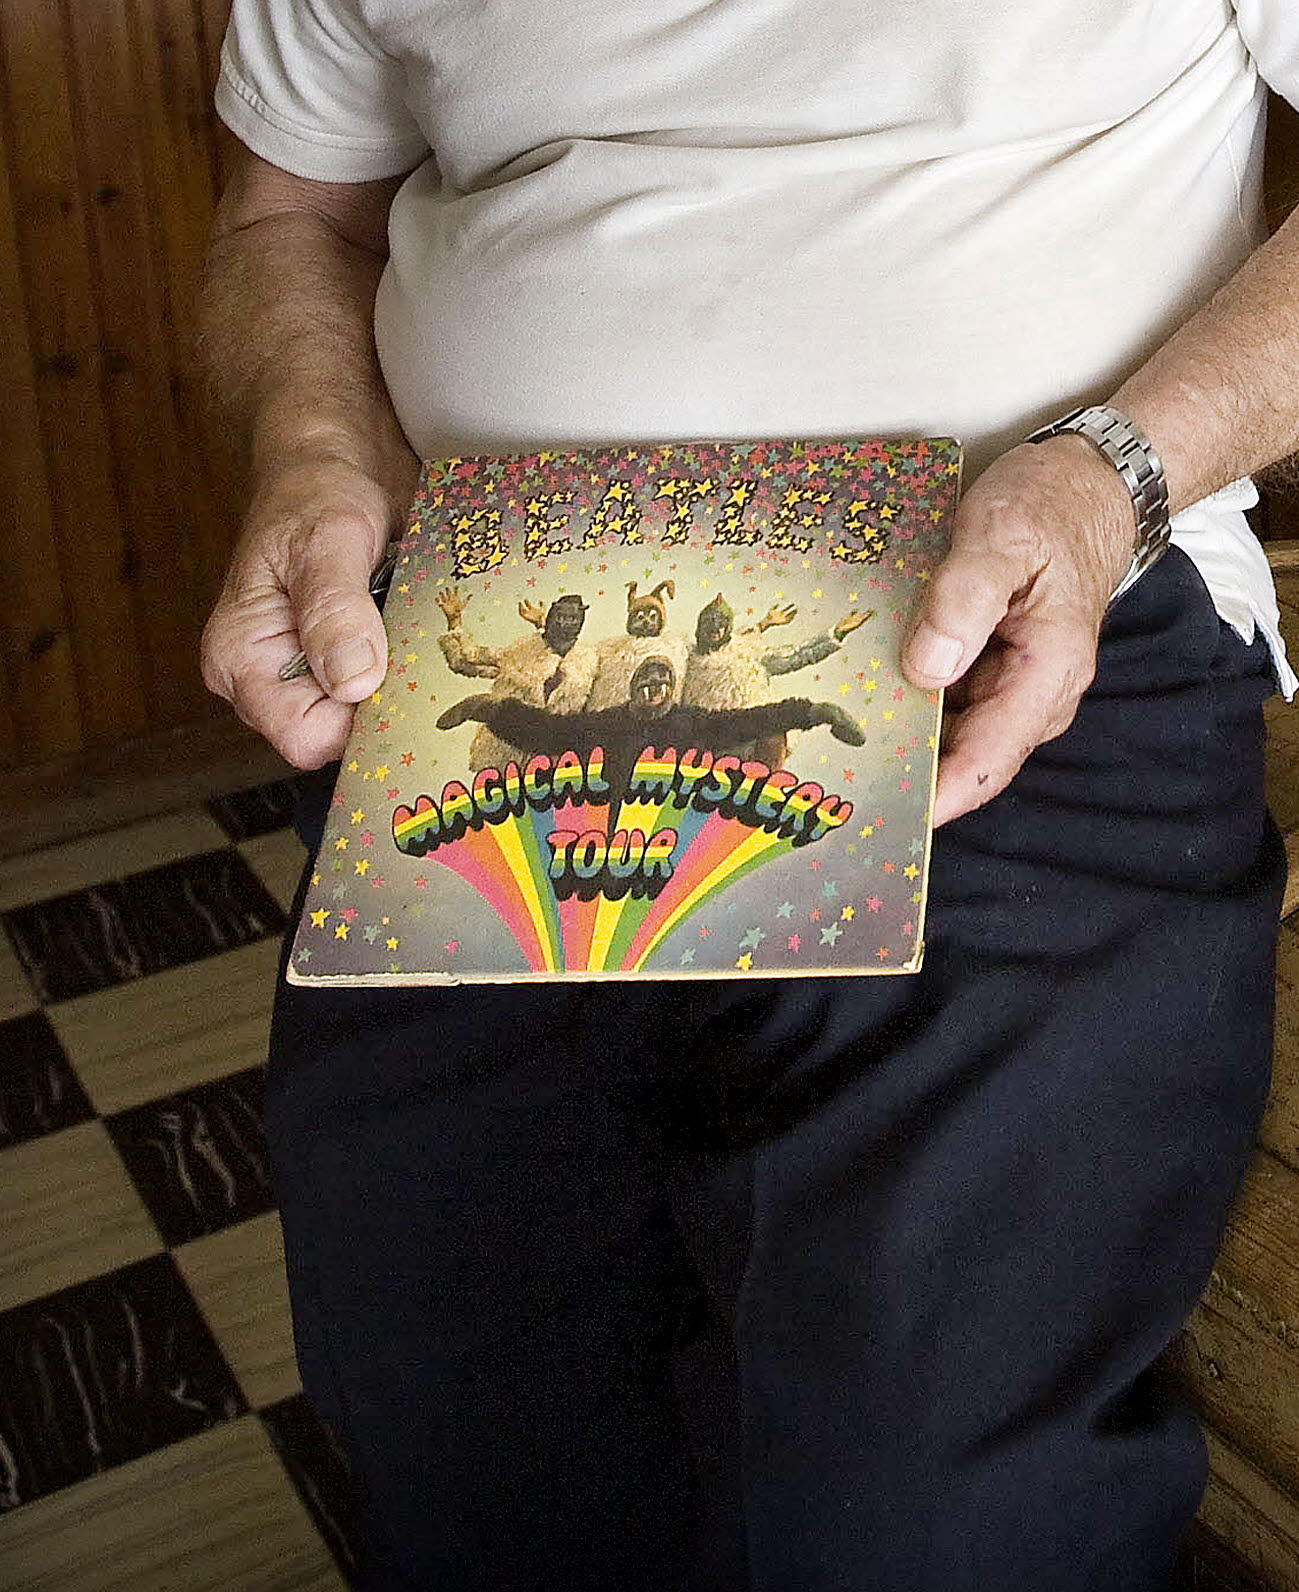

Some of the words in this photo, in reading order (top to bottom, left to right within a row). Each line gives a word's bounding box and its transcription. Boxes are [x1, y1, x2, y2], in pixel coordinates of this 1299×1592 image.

[449, 477, 905, 580] BEATLES
[391, 746, 612, 858] MAGICAL
[628, 745, 855, 848] MYSTERY
[547, 828, 678, 901] TOUR
